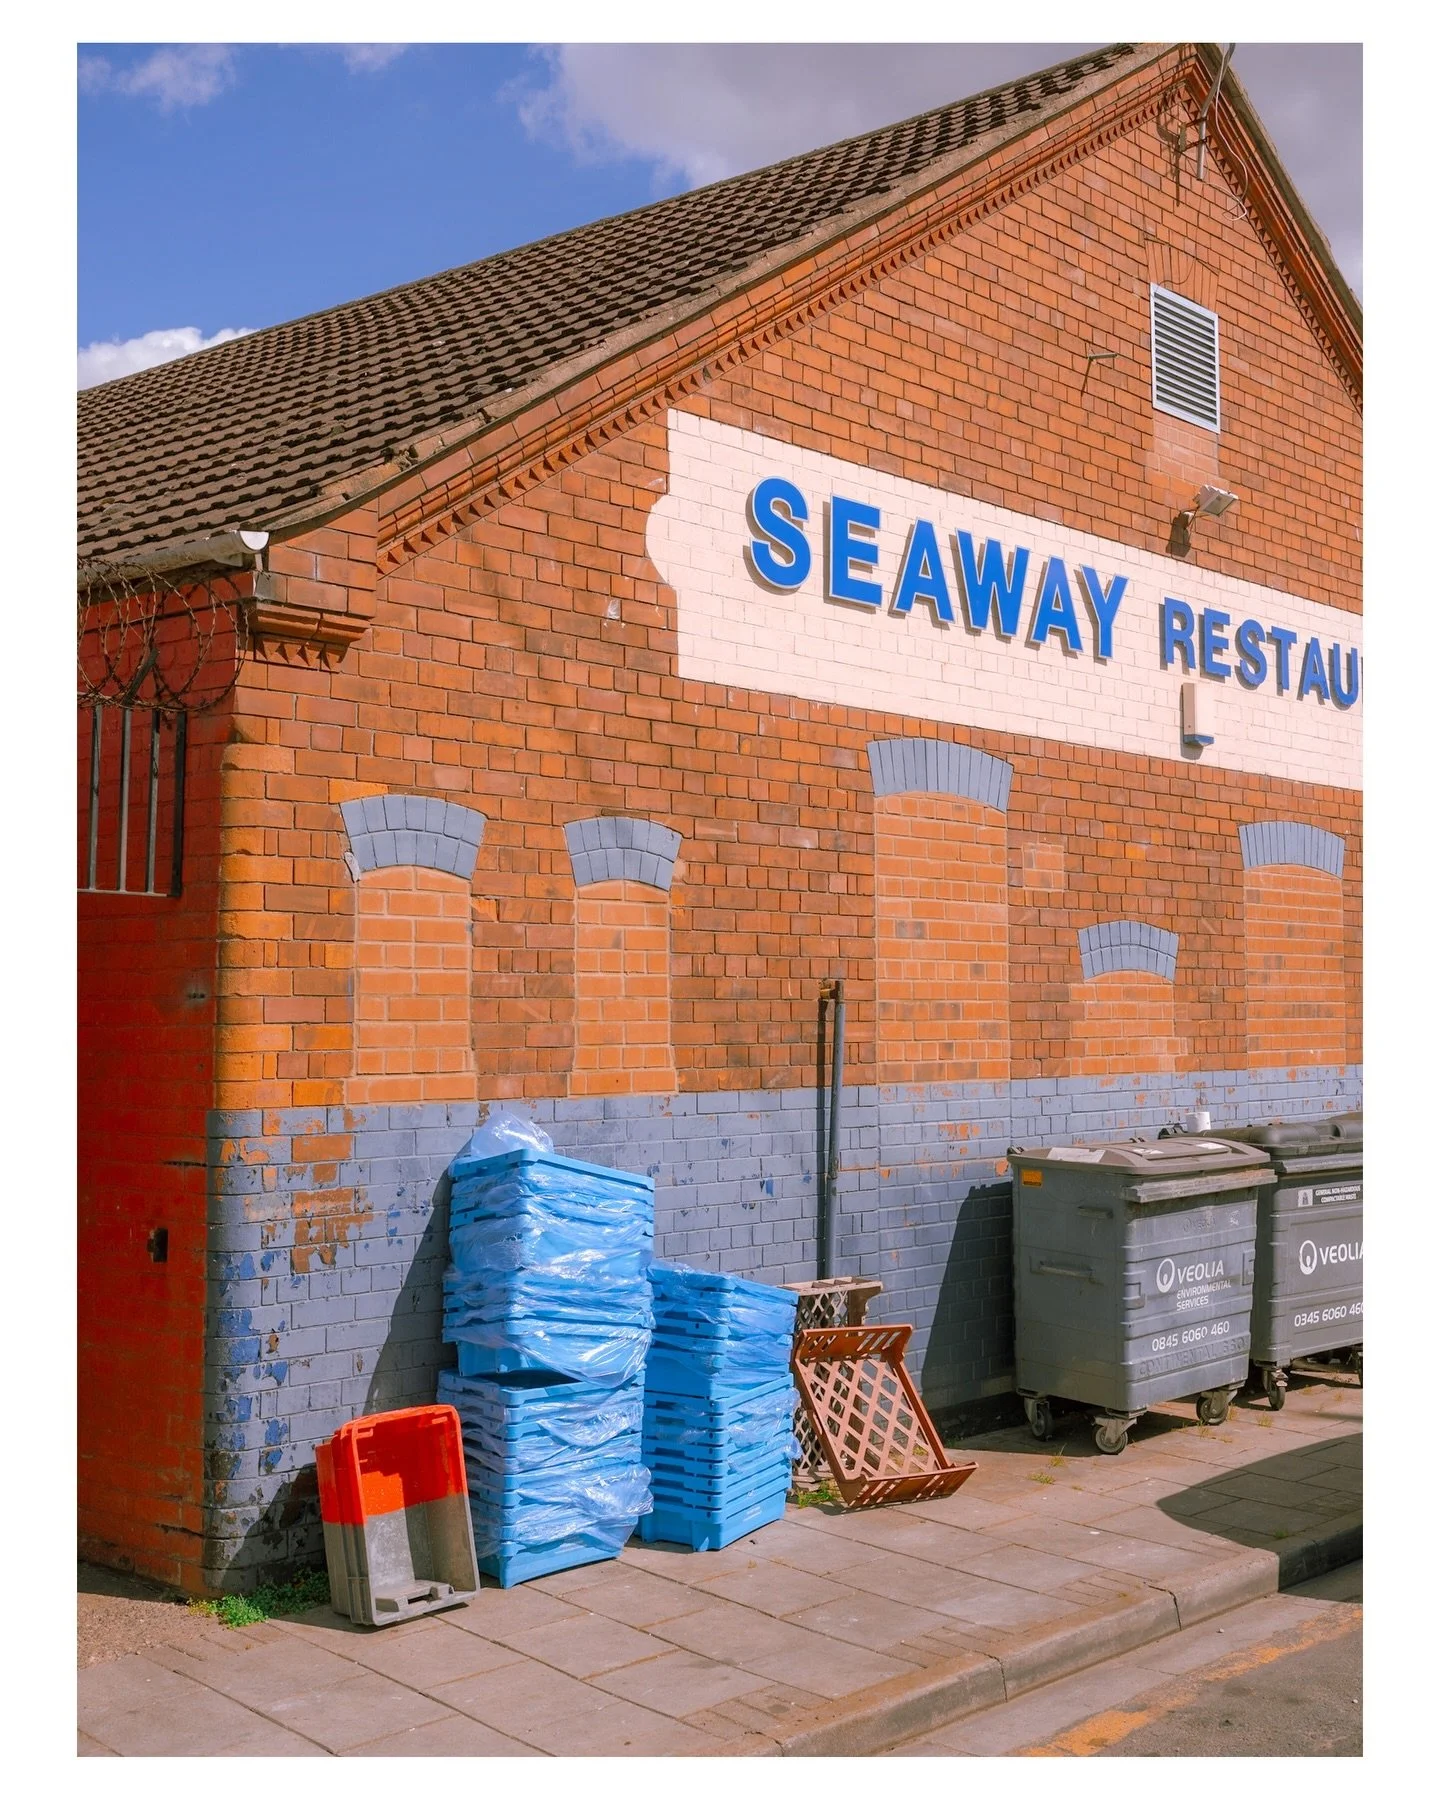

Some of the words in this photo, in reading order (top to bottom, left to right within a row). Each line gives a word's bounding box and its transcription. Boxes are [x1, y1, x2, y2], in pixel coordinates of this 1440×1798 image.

[750, 475, 1130, 660] SEAWAY
[1177, 1260, 1224, 1284] VEOLIA
[1177, 1280, 1232, 1300] ENVIRONMENTAL
[1176, 1295, 1209, 1311] SERVICES
[1294, 1311, 1320, 1327] 0345
[1321, 1305, 1347, 1322] 6060
[1151, 1333, 1179, 1352] 0845
[1181, 1326, 1208, 1344] 6060
[1210, 1320, 1230, 1336] 460
